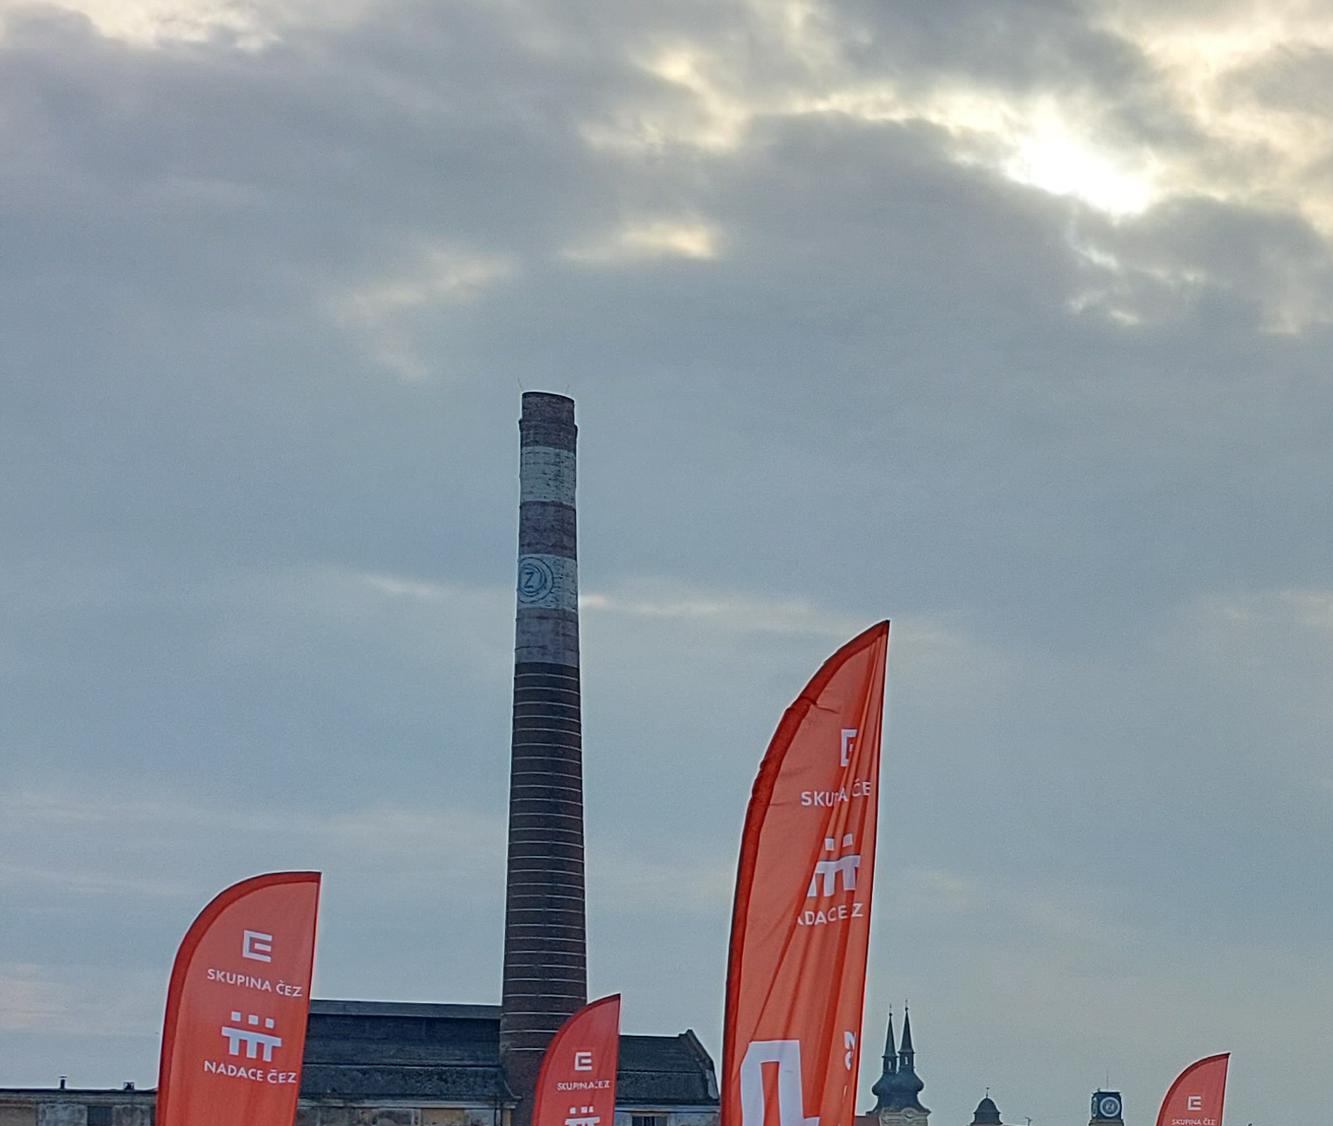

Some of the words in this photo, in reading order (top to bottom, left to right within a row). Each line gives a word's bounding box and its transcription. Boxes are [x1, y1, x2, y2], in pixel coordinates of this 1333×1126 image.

[207, 968, 272, 993] SKUPINA
[275, 979, 303, 997] ČEZ
[203, 1059, 263, 1082] NADACE
[266, 1068, 297, 1085] ČEZ
